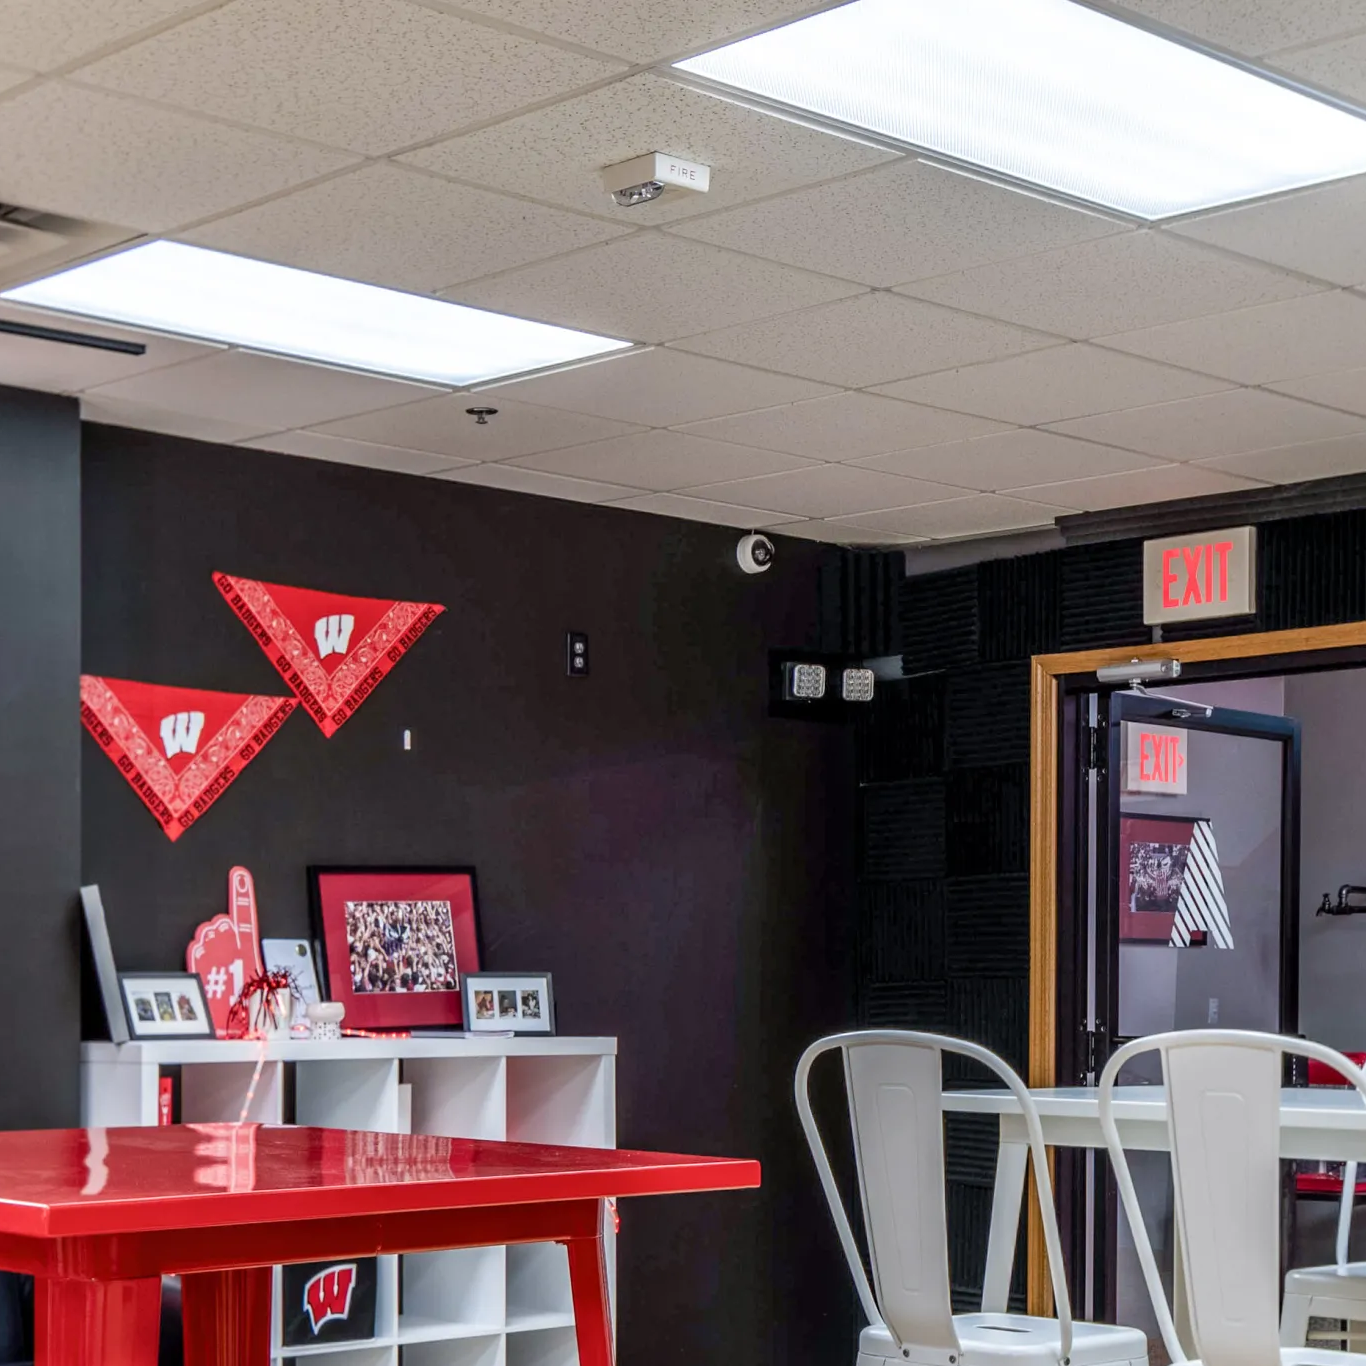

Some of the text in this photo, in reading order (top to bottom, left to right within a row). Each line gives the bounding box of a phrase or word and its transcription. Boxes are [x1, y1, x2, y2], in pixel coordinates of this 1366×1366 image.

[670, 164, 696, 181] FIRE
[1162, 542, 1233, 608] EXIT
[217, 575, 326, 724] GO BADGERS GO BADGERS
[314, 614, 355, 660] W
[332, 607, 436, 726] GO BADGERS GO BADGERS
[160, 711, 205, 759] W
[178, 699, 294, 827] GO BADGERS GO BADGERS
[1139, 732, 1180, 783] EXIT
[118, 755, 133, 773] GO
[131, 771, 174, 825] BADGERS
[206, 959, 244, 1004] #1
[303, 1263, 357, 1335] W
